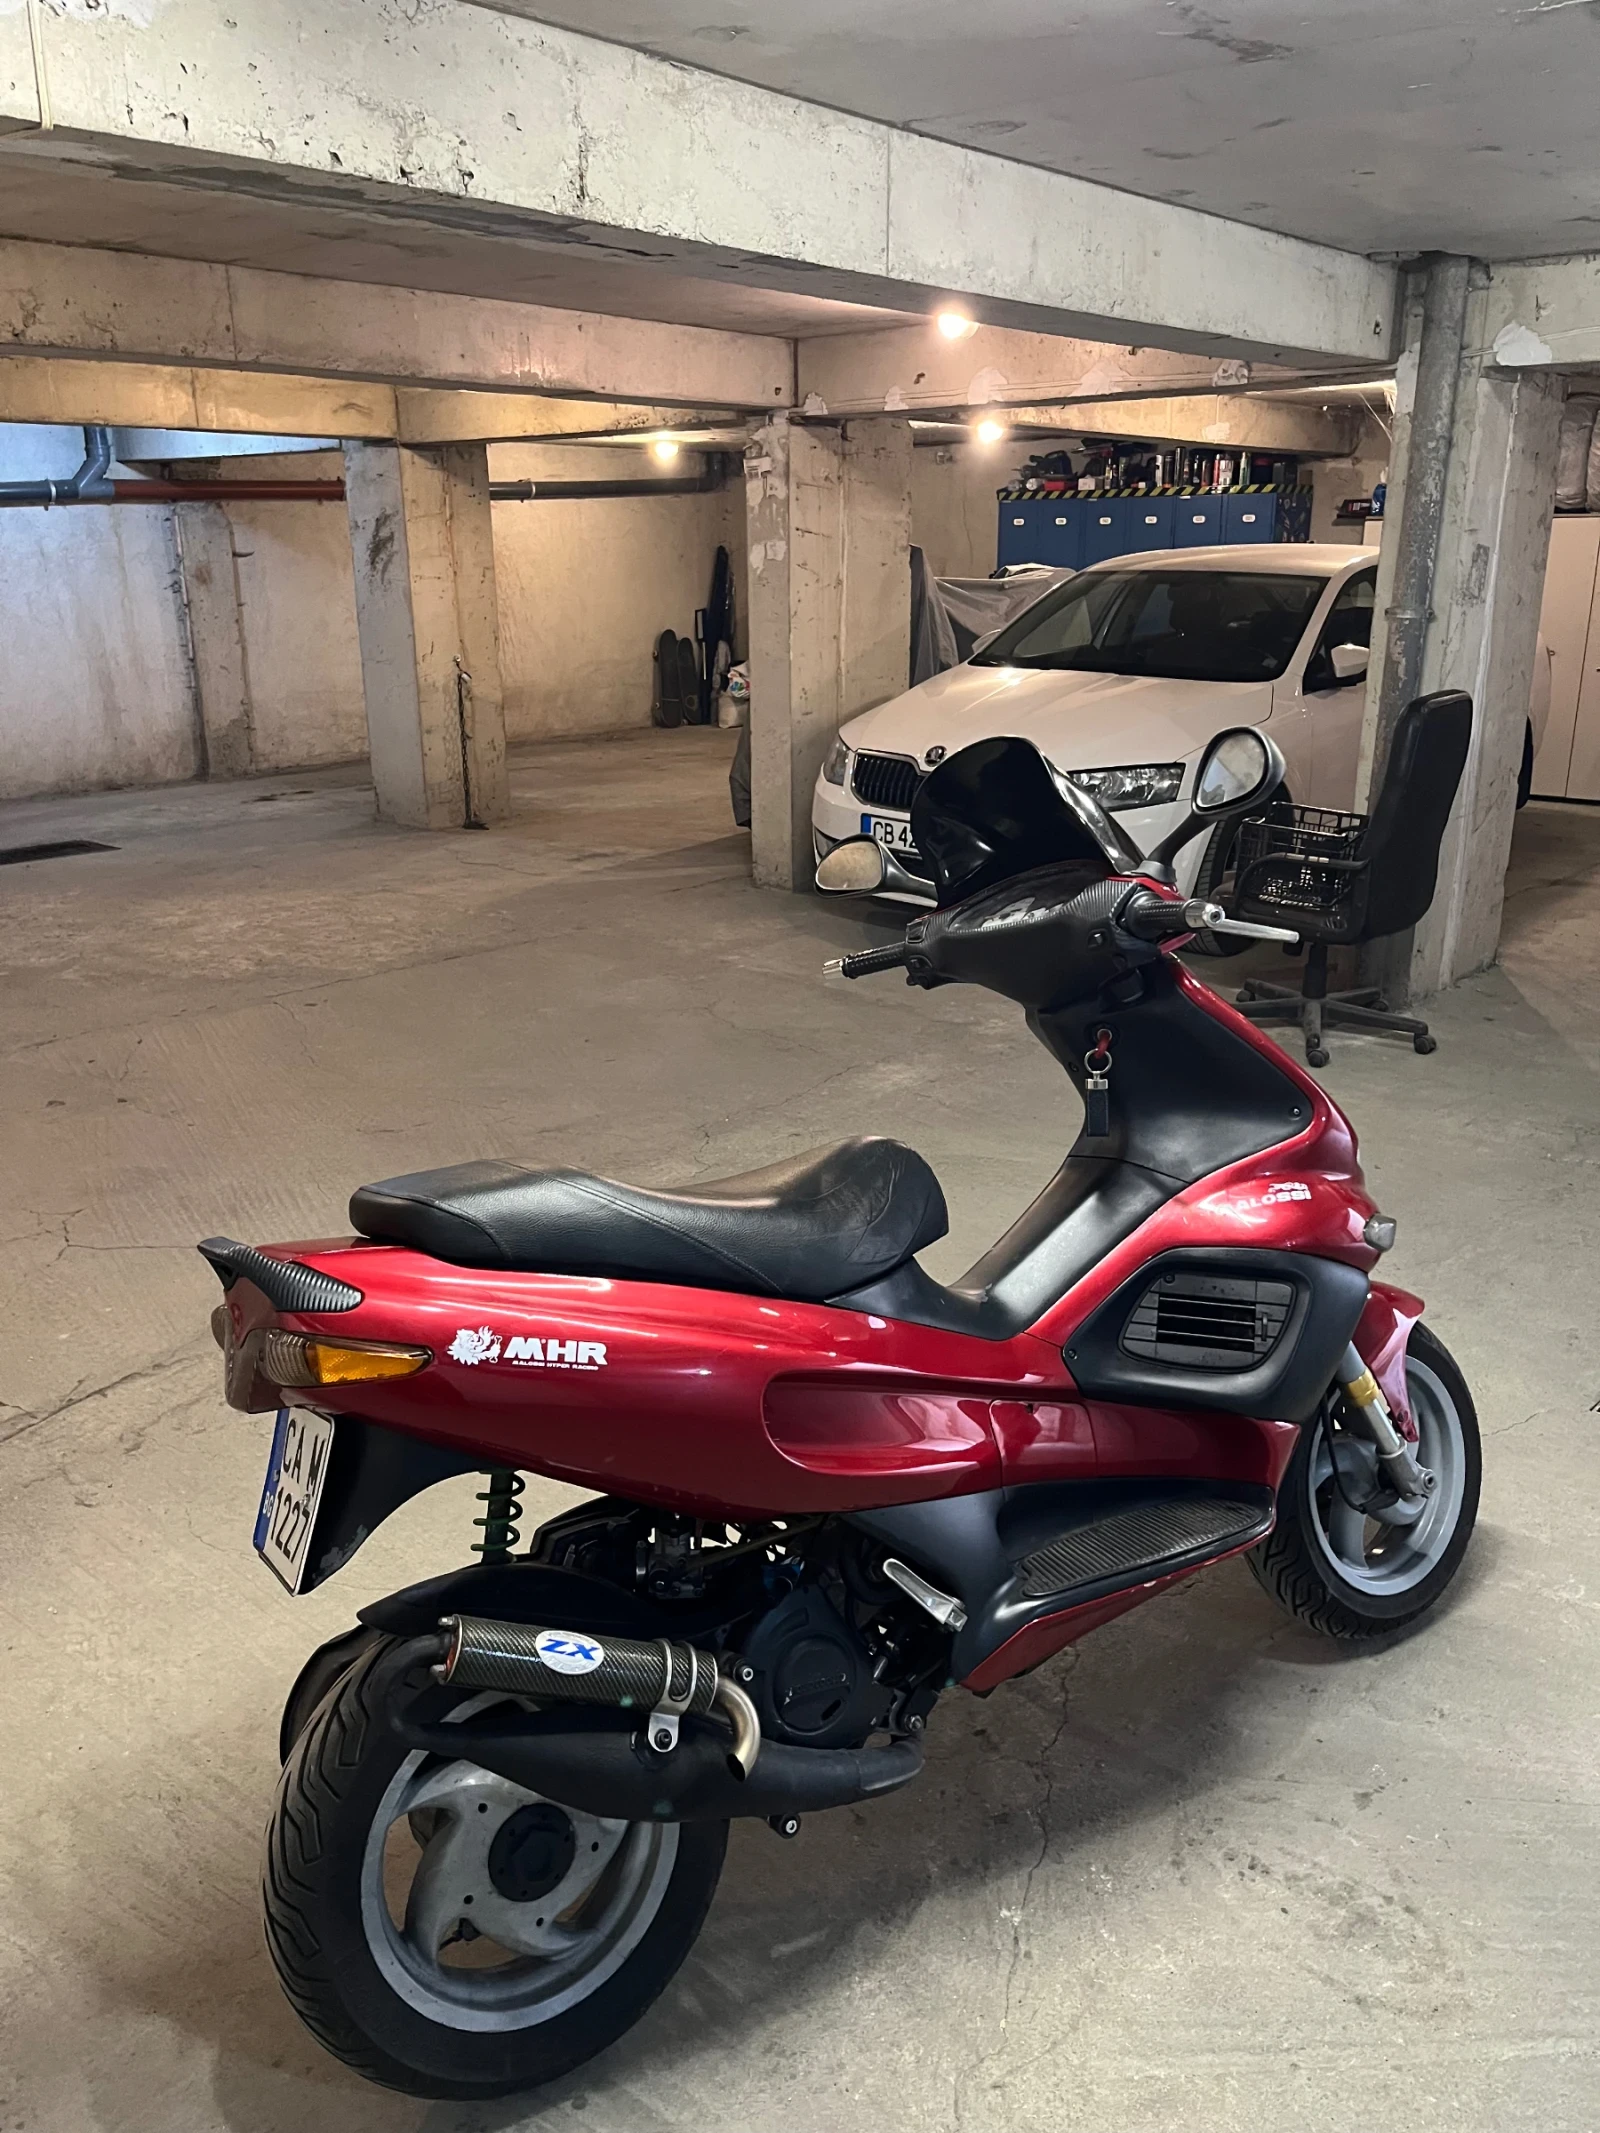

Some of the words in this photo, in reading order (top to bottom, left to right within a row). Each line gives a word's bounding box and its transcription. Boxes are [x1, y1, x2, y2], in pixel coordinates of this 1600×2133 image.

[873, 821, 894, 844] CB
[1218, 1190, 1312, 1213] ALOSSI
[503, 1336, 608, 1365] MHR
[282, 1418, 306, 1484] CA
[306, 1433, 327, 1497] M
[270, 1486, 311, 1564] 1227
[540, 1638, 601, 1661] ZX
